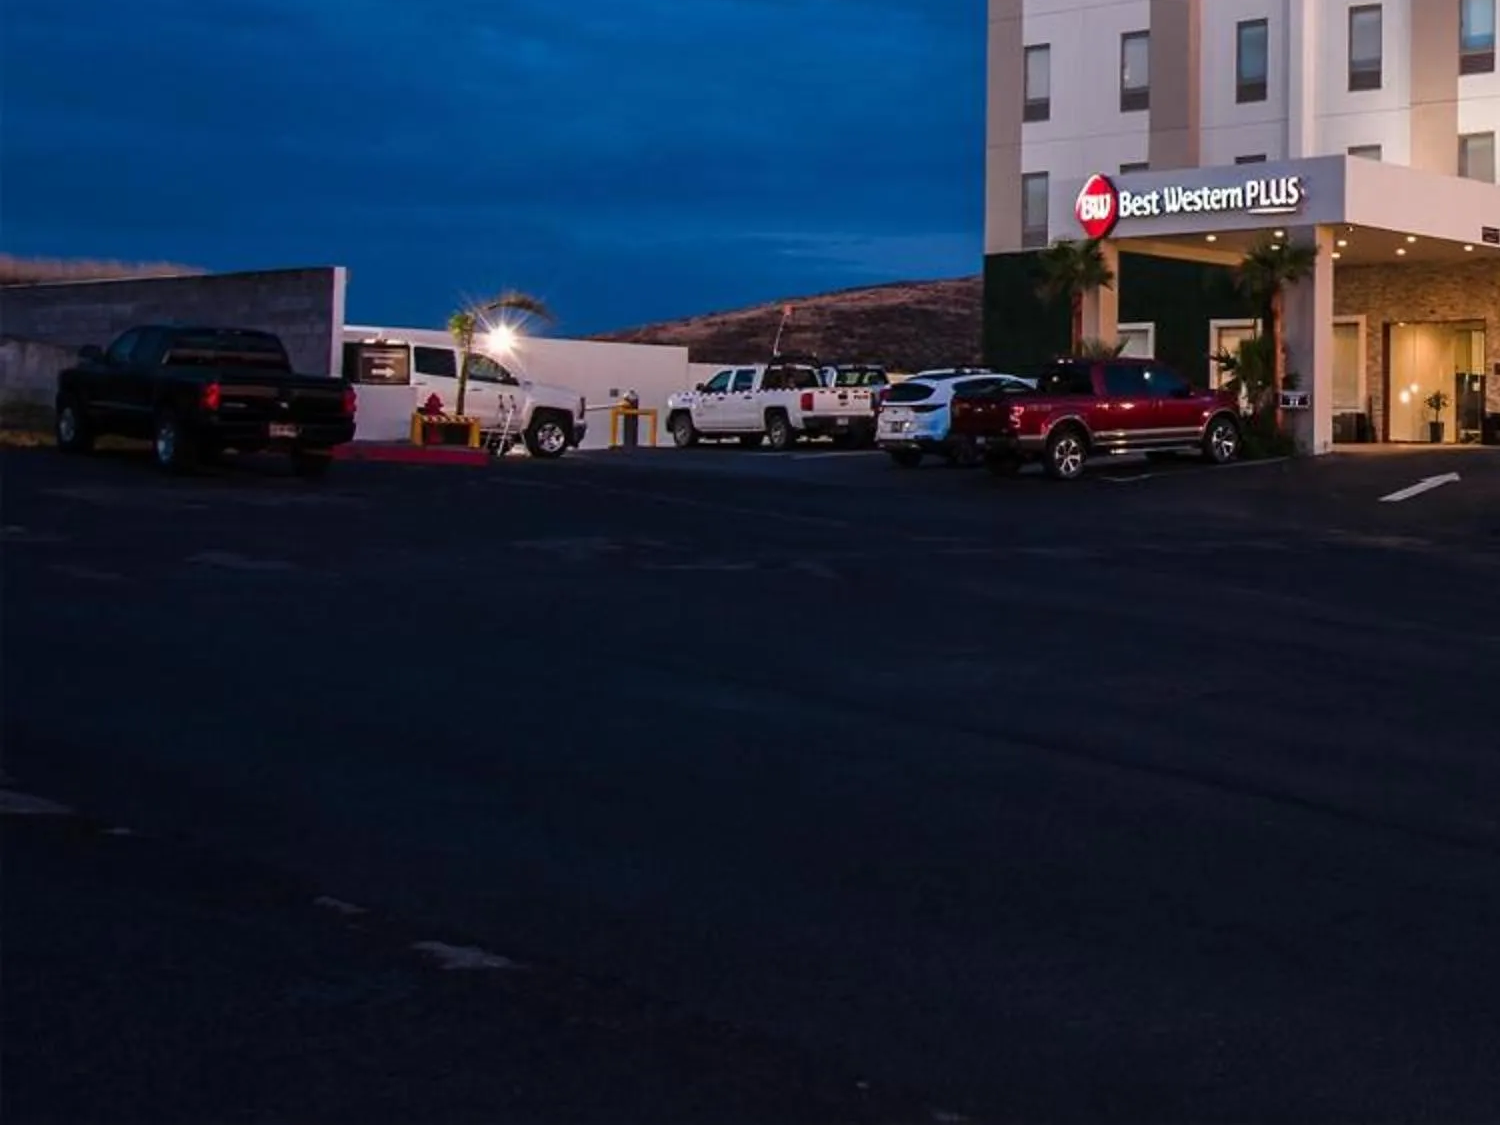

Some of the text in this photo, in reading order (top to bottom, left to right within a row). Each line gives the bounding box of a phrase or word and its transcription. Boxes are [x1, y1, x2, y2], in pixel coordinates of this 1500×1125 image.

[1081, 193, 1111, 221] BW
[1119, 176, 1300, 217] Best Western PLUS
